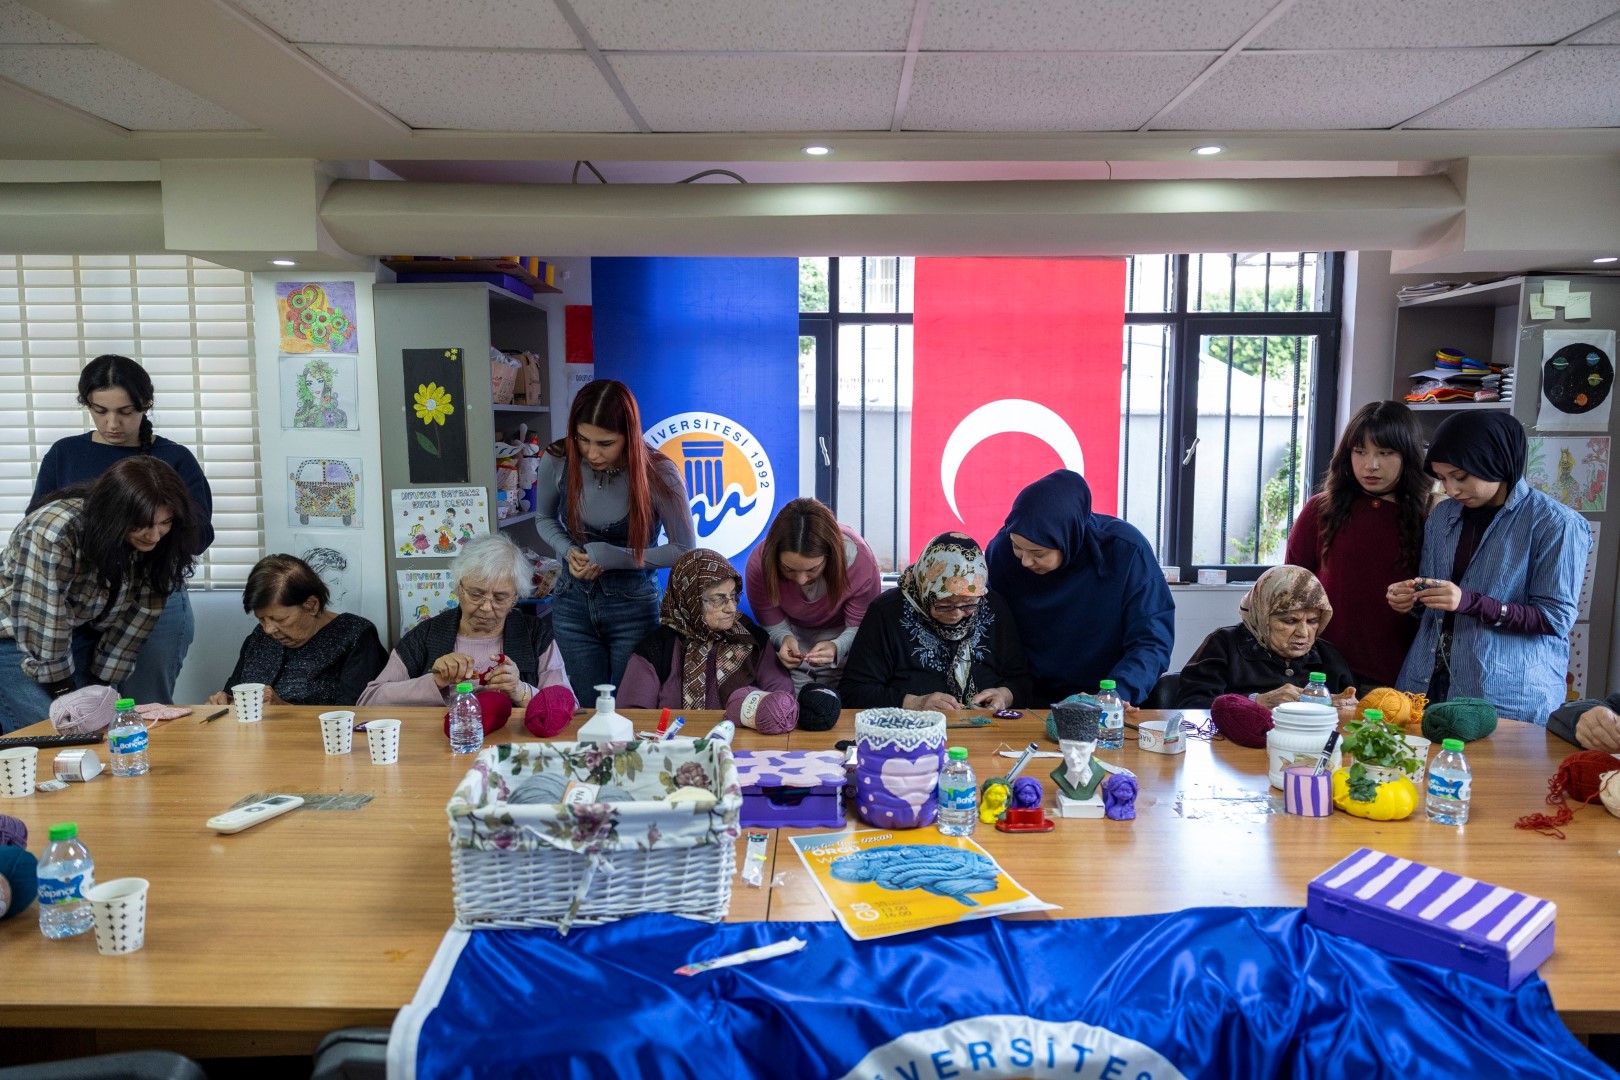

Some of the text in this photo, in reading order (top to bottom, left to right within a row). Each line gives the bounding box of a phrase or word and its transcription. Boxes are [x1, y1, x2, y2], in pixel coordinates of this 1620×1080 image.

[648, 419, 769, 488] İVERSİTESİ 1992
[816, 849, 912, 864] WORKSHOP
[873, 1037, 1153, 1080] VERSİTE
